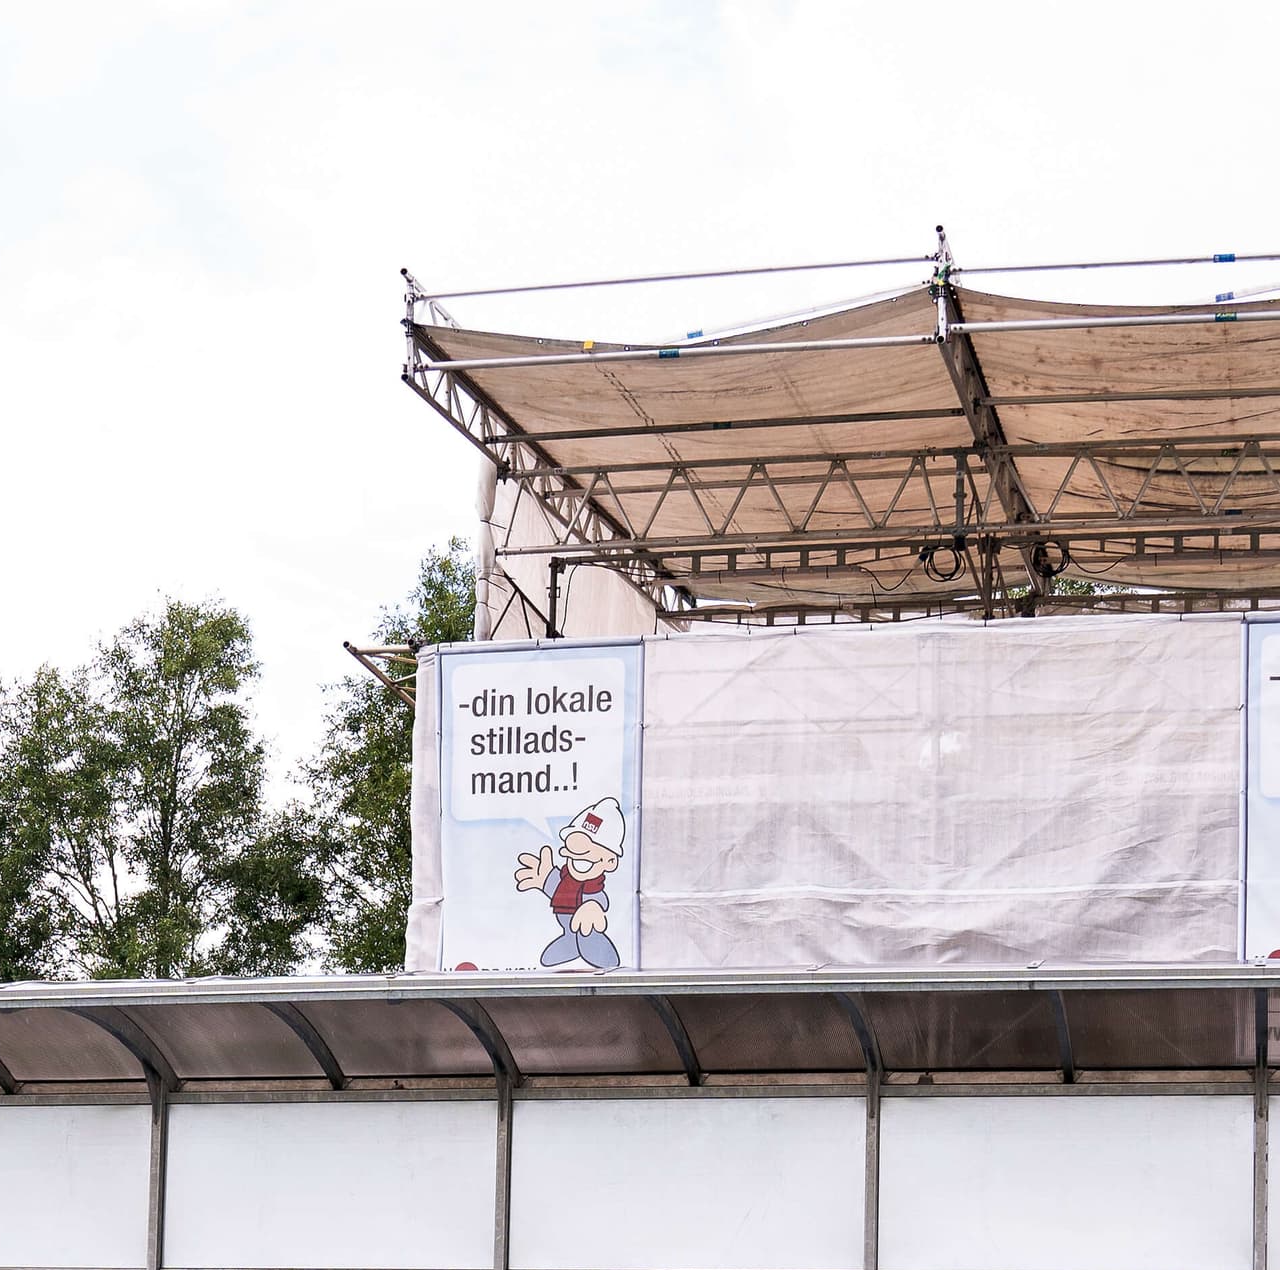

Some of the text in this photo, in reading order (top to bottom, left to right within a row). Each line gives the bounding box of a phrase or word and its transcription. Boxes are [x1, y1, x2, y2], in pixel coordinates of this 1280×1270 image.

[458, 685, 612, 718] -din lokale
[470, 724, 586, 756] stillads-
[471, 761, 578, 795] mand..!
